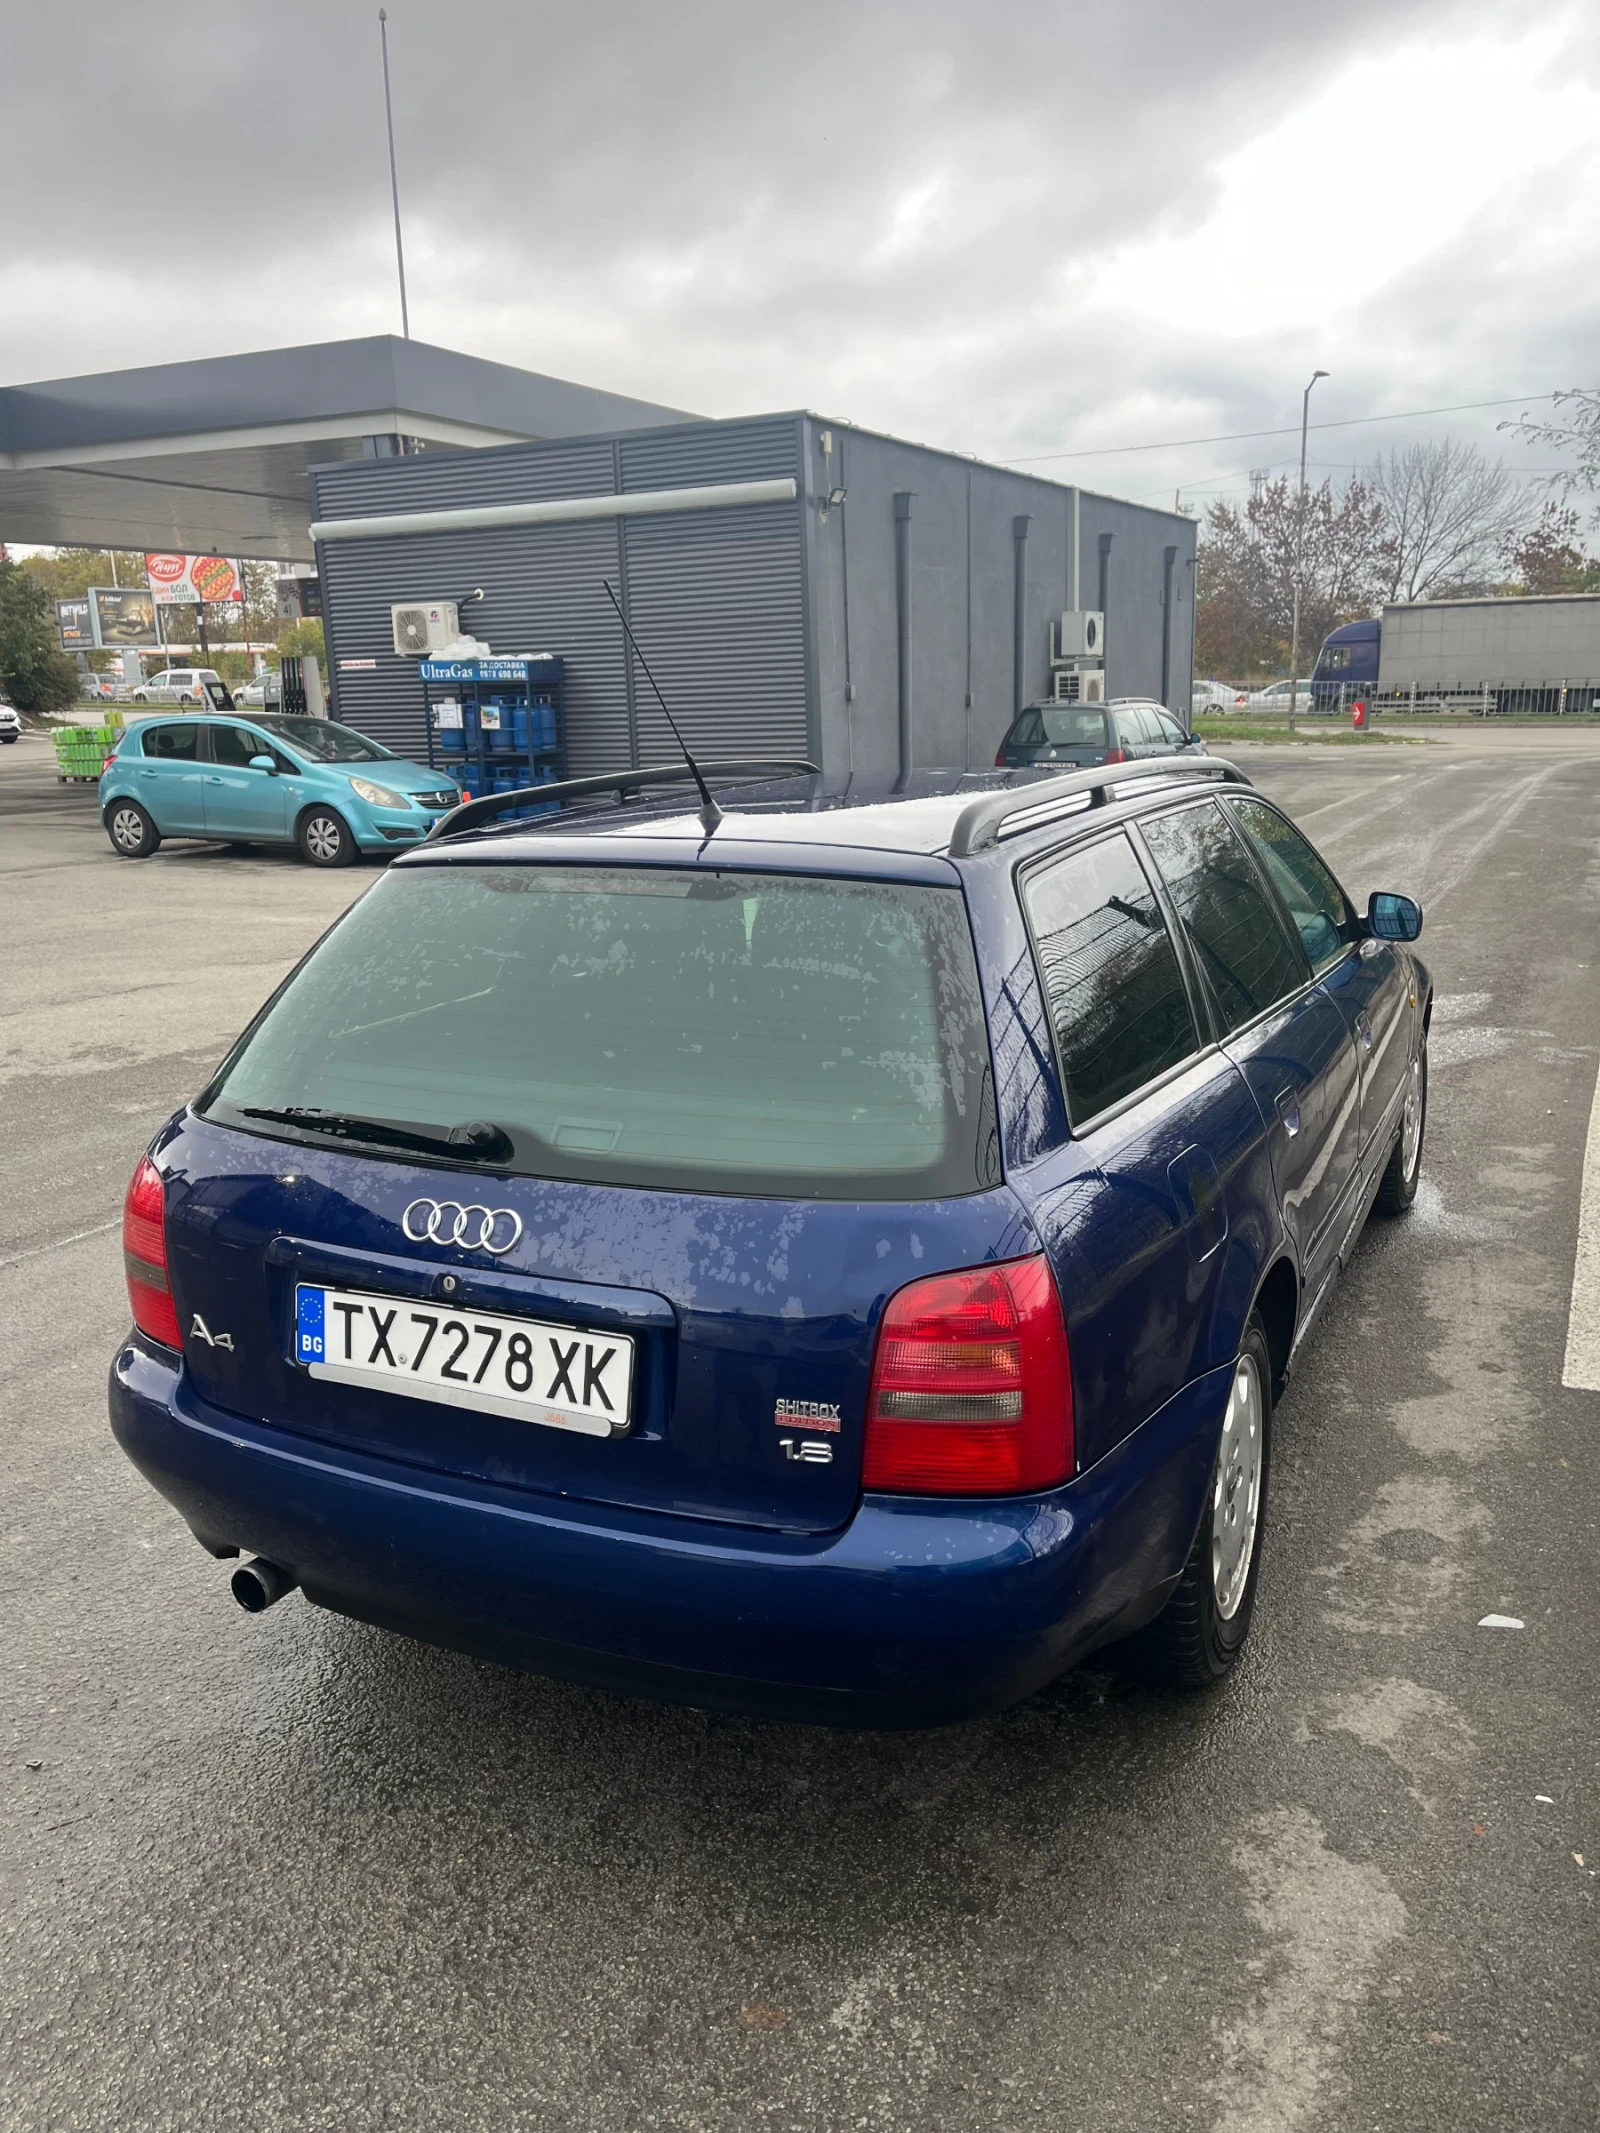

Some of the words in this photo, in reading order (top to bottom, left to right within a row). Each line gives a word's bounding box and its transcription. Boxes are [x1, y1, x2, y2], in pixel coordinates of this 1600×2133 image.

[152, 561, 180, 573] Happy
[170, 584, 188, 593] БОЛ
[420, 663, 473, 678] UltraGas
[478, 661, 488, 669] ЗА
[489, 661, 525, 669] ДОСТАВКА
[189, 1313, 235, 1353] A4
[301, 1334, 323, 1353] BG
[775, 1398, 841, 1420] SHITBOX
[778, 1415, 837, 1429] EDITION
[779, 1439, 834, 1464] 1.8
